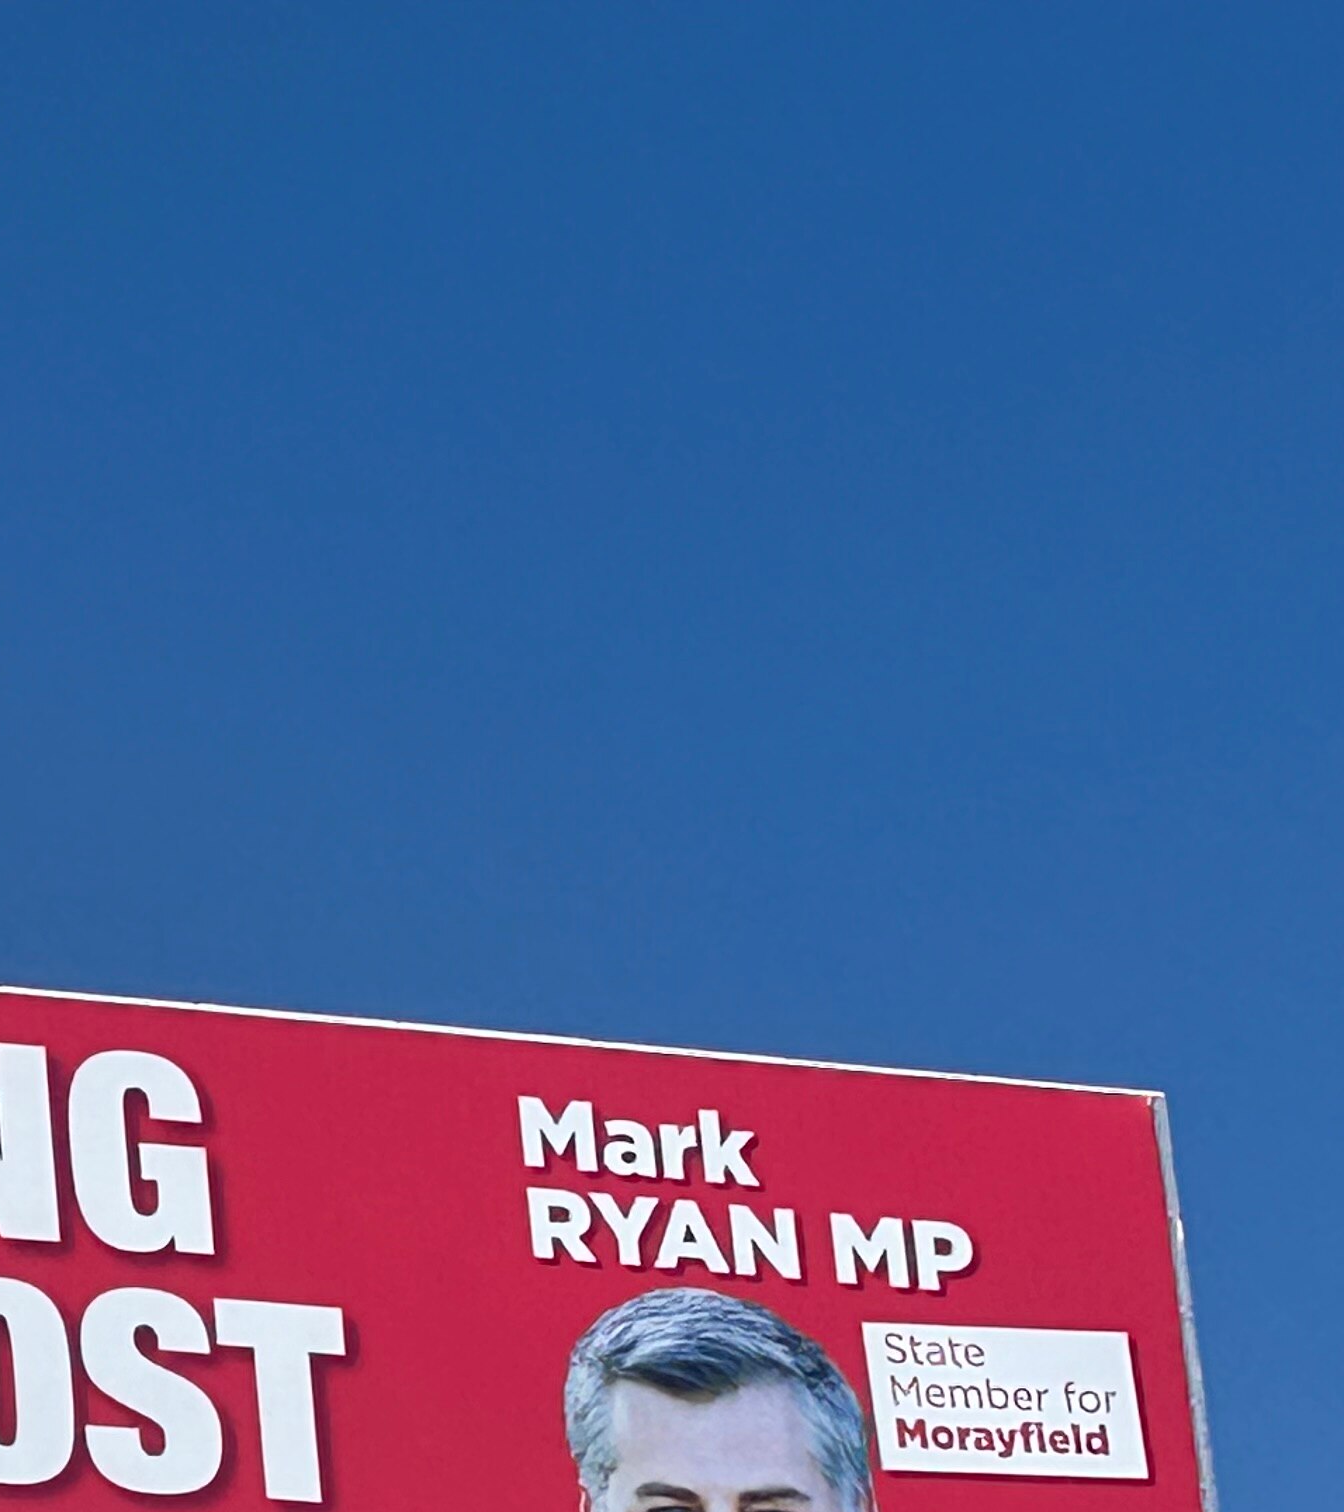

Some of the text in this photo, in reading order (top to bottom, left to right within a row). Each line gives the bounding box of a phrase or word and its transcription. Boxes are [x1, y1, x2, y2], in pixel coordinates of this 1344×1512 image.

[517, 1095, 760, 1187] Mark
[526, 1186, 973, 1291] RYAN MP
[884, 1332, 985, 1369] State
[890, 1374, 1117, 1414] Member for
[895, 1417, 1110, 1458] Morayfield
